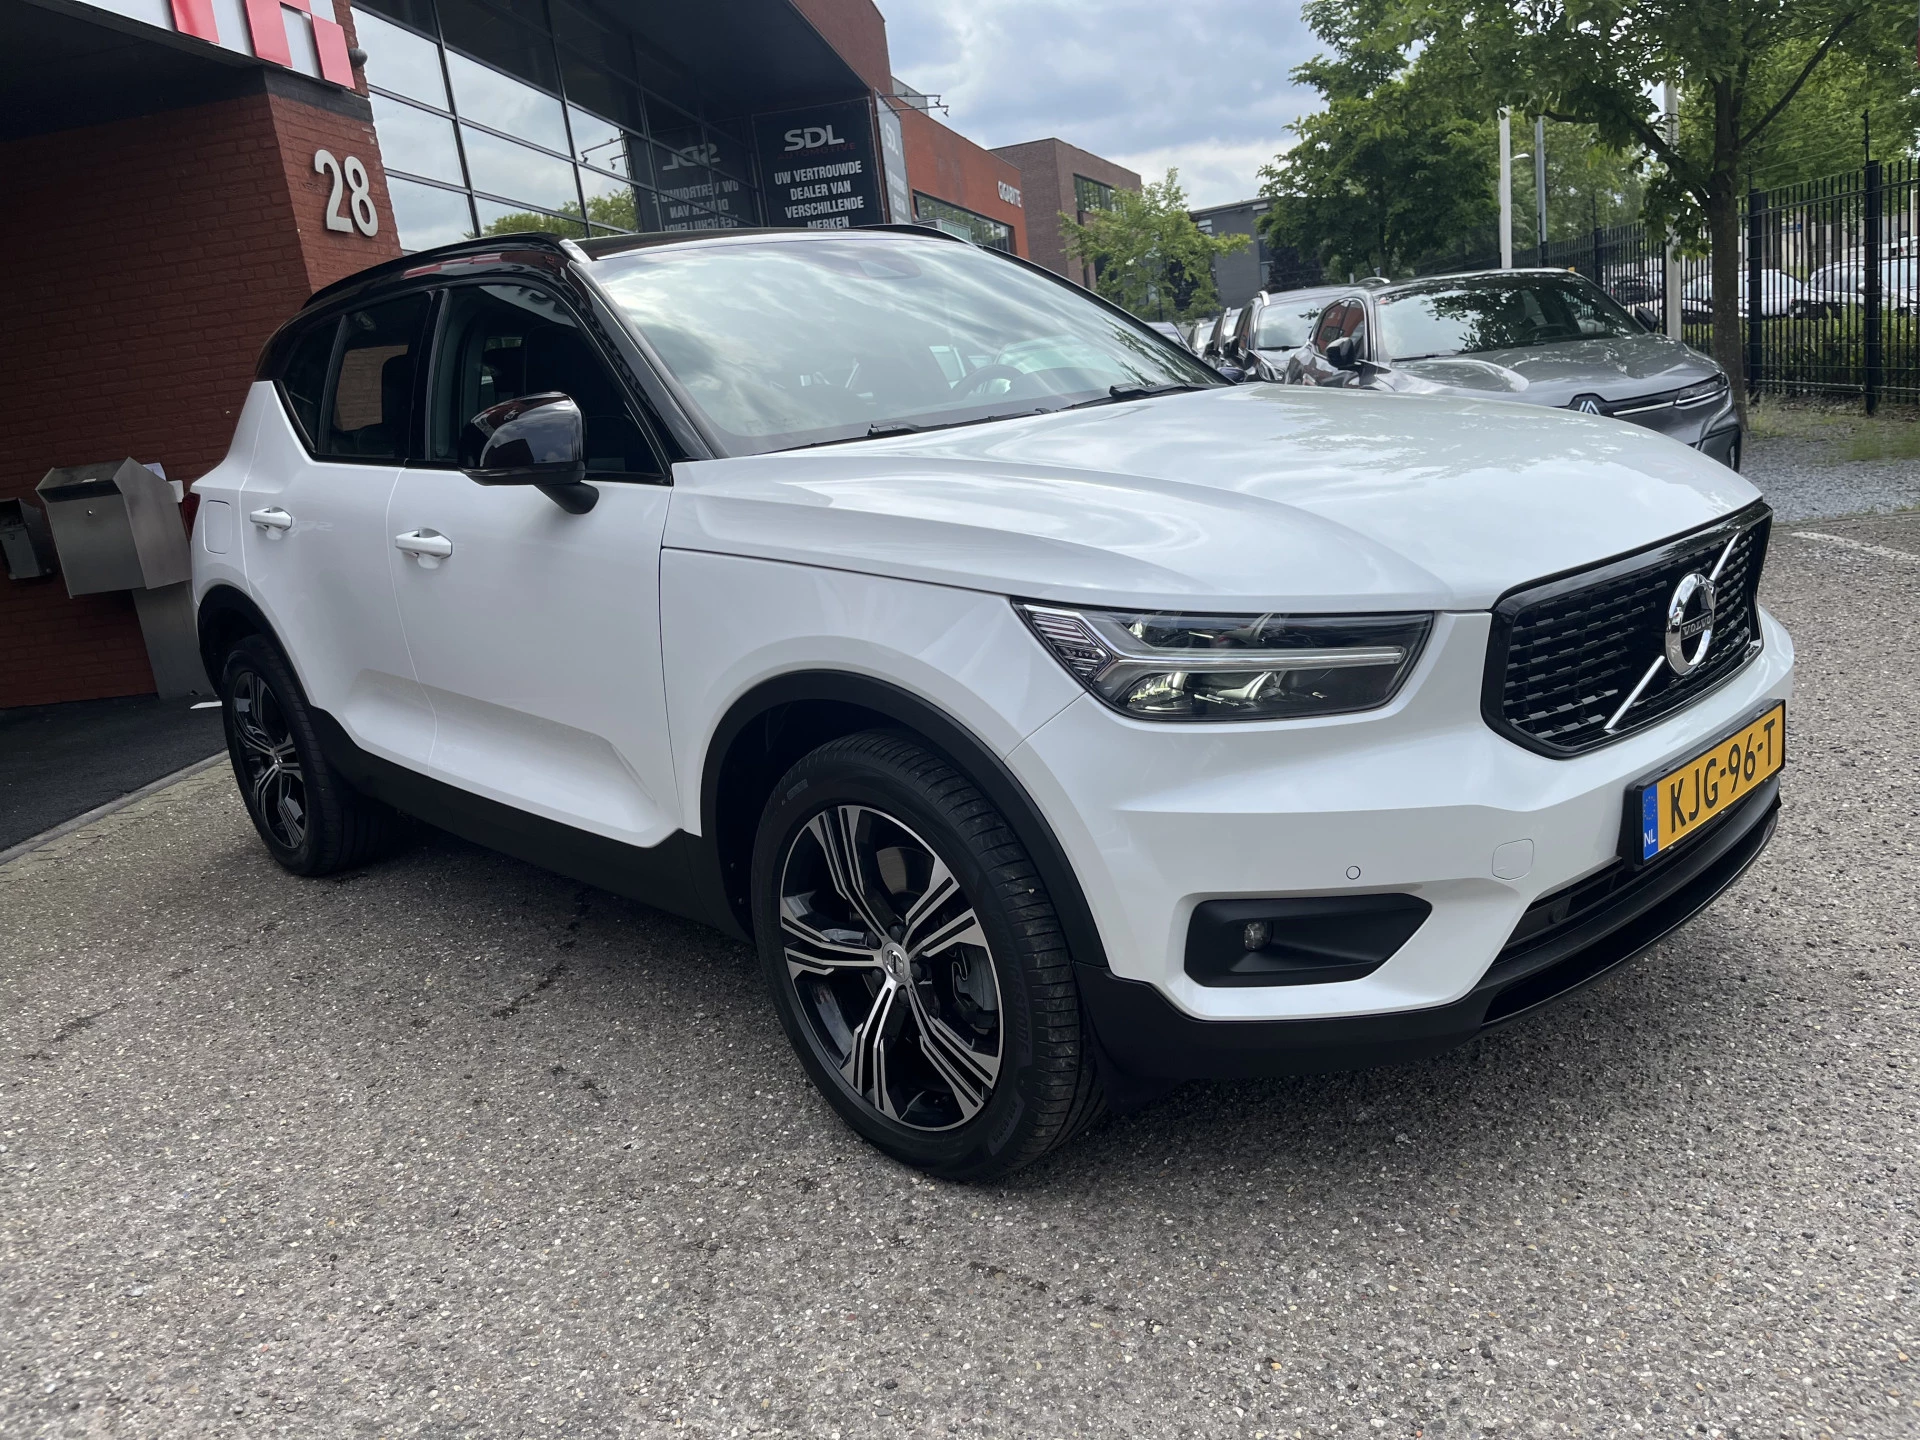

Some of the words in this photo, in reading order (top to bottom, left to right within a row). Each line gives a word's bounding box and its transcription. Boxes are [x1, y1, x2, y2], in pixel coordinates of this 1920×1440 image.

[784, 124, 845, 152] SDL
[777, 142, 857, 160] AUTOMOTIVE
[774, 171, 792, 185] UW
[793, 160, 863, 182] VERTROUWDE
[314, 149, 379, 237] 28
[790, 183, 829, 201] DEALER
[830, 180, 852, 197] VAN
[784, 196, 865, 219] VERSCHILLENDE
[807, 216, 850, 230] MERKEN
[1682, 615, 1712, 637] VOLVO
[1670, 718, 1776, 834] KJG-96-T
[1643, 828, 1657, 848] NL
